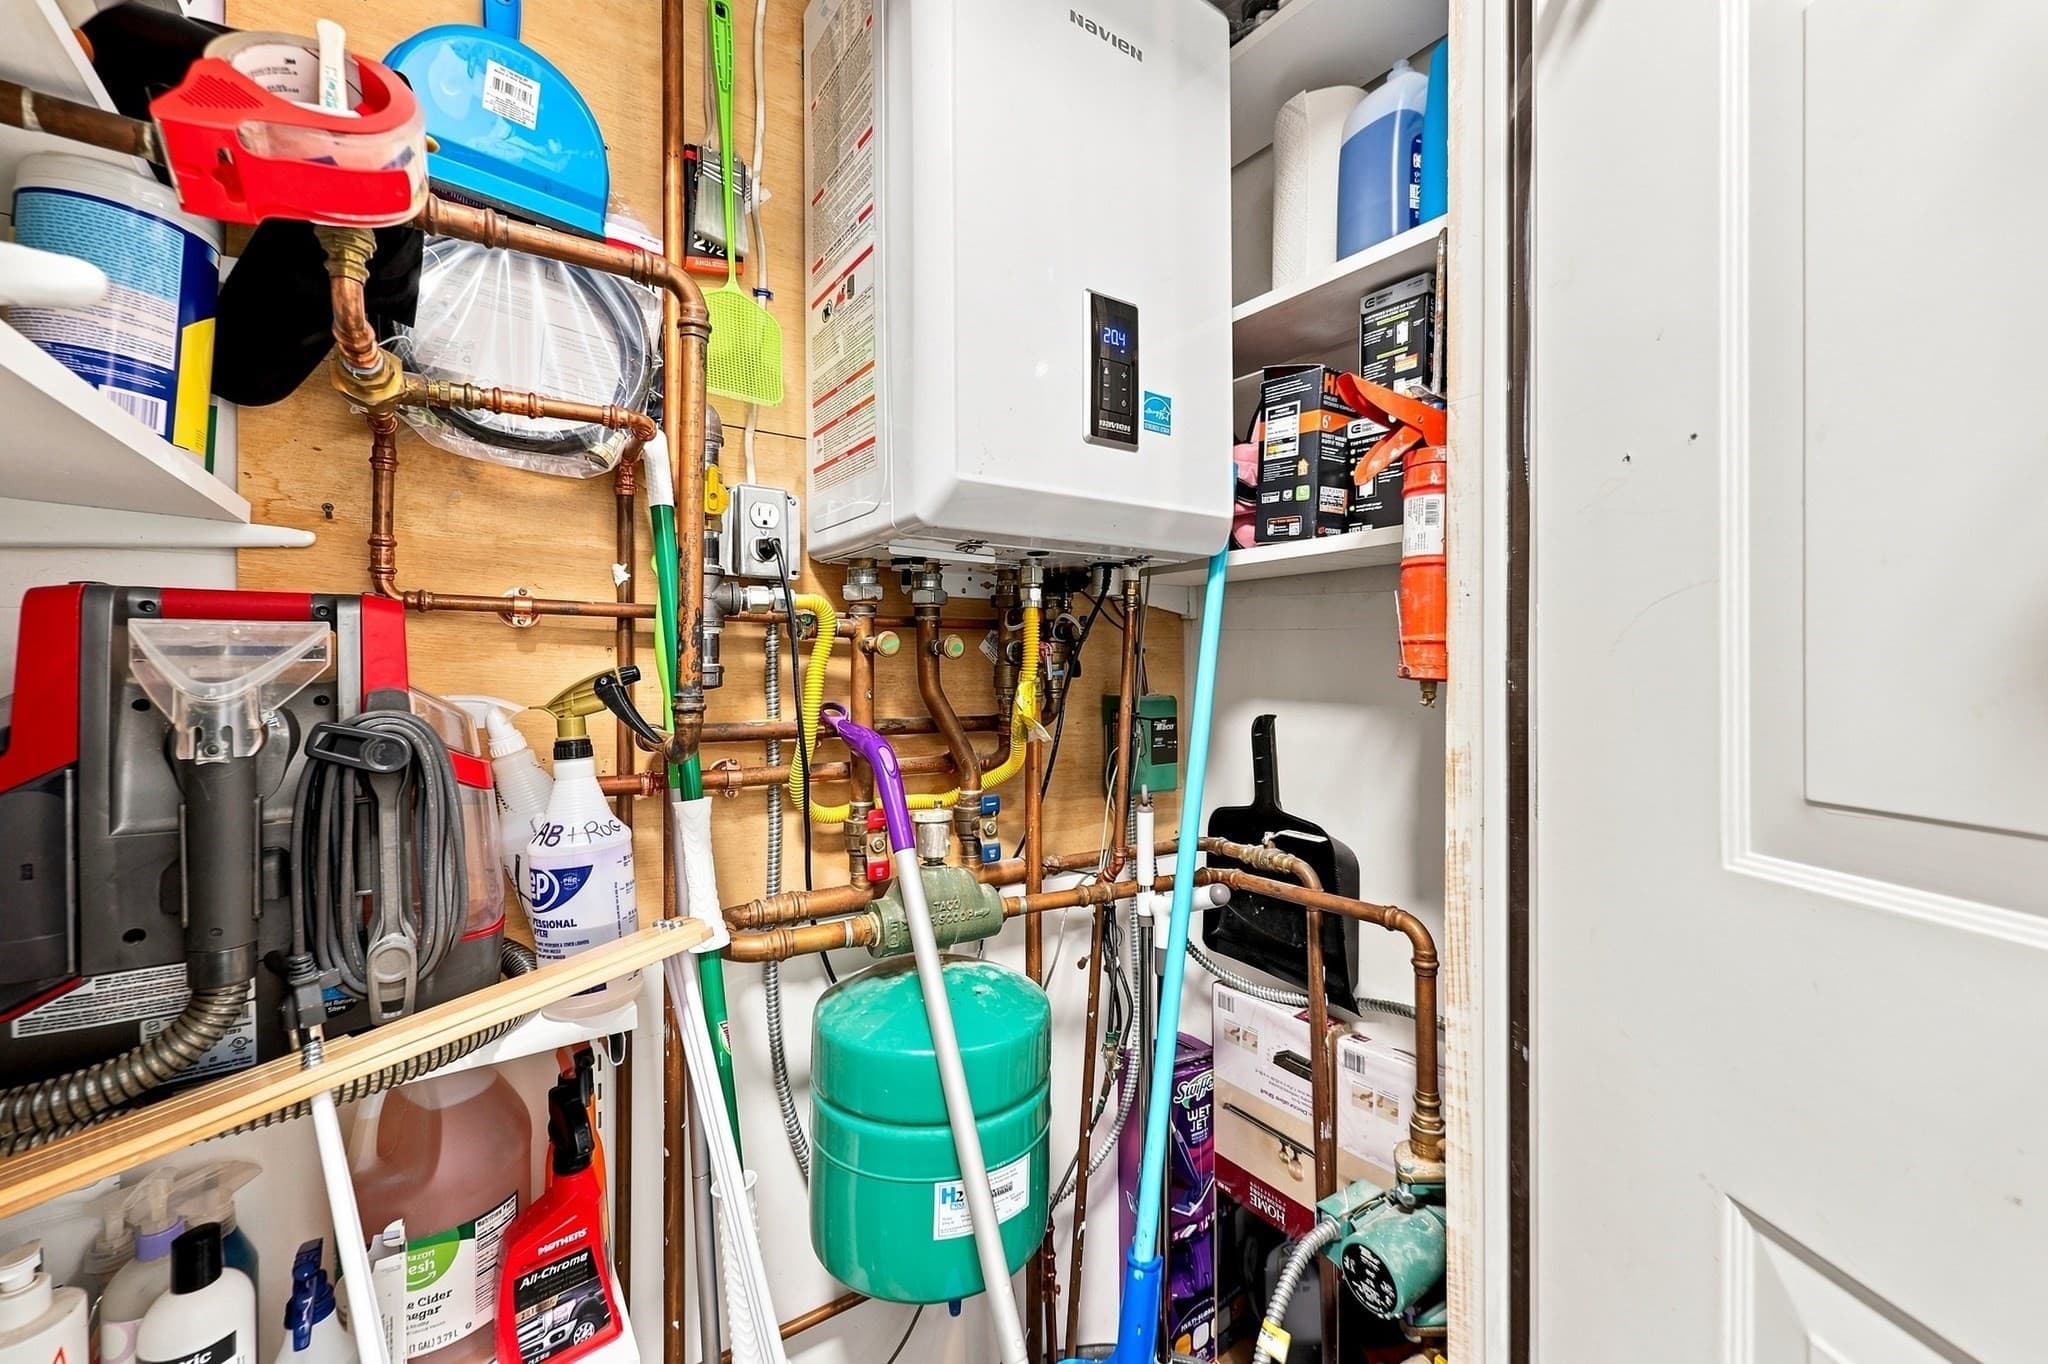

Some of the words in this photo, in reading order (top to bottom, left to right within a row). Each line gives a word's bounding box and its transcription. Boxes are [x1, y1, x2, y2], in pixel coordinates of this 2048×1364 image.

[1173, 1073, 1214, 1104] Swiffe
[1186, 1103, 1212, 1121] WET
[1190, 1117, 1209, 1132] JET
[1249, 1192, 1286, 1225] HOME
[537, 1227, 589, 1256] MOTHERS
[519, 1251, 589, 1291] All-Chrome
[417, 1289, 453, 1307] Cider
